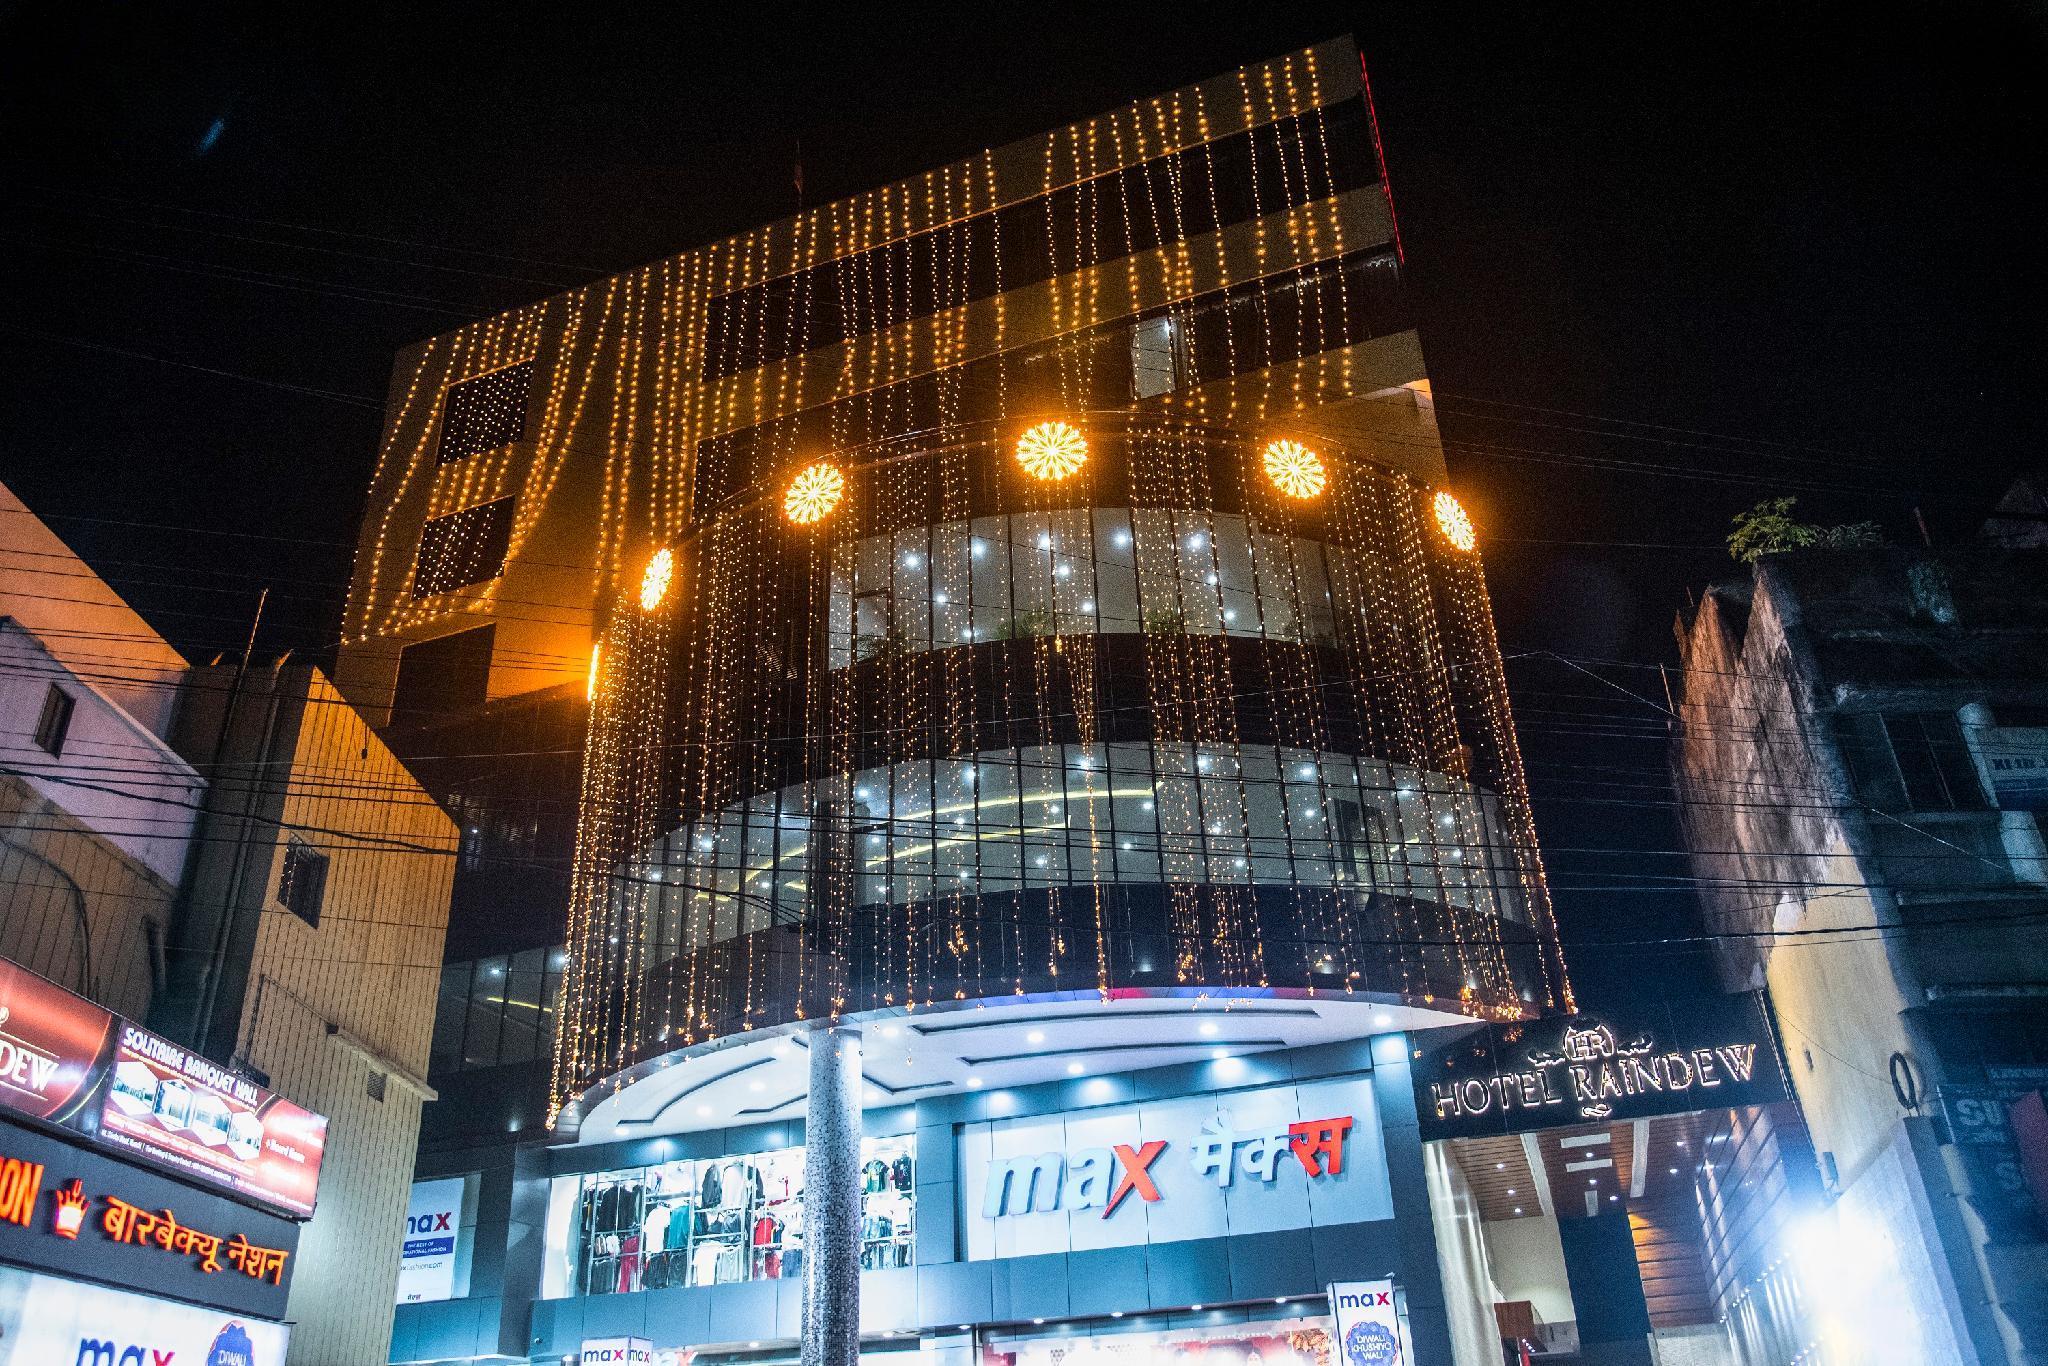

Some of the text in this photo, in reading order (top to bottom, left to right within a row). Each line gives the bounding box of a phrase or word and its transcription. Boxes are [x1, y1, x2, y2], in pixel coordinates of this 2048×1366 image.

[184, 1055, 236, 1091] BANQUET
[237, 1078, 258, 1105] HALL
[1432, 1042, 1757, 1119] HOTEL RAINDEW
[0, 1156, 45, 1228] ON
[981, 1139, 1168, 1220] max
[103, 1194, 289, 1286] बारबेक्यू नेशन
[1340, 1291, 1391, 1309] max
[583, 1349, 625, 1363] max
[629, 1348, 650, 1364] max
